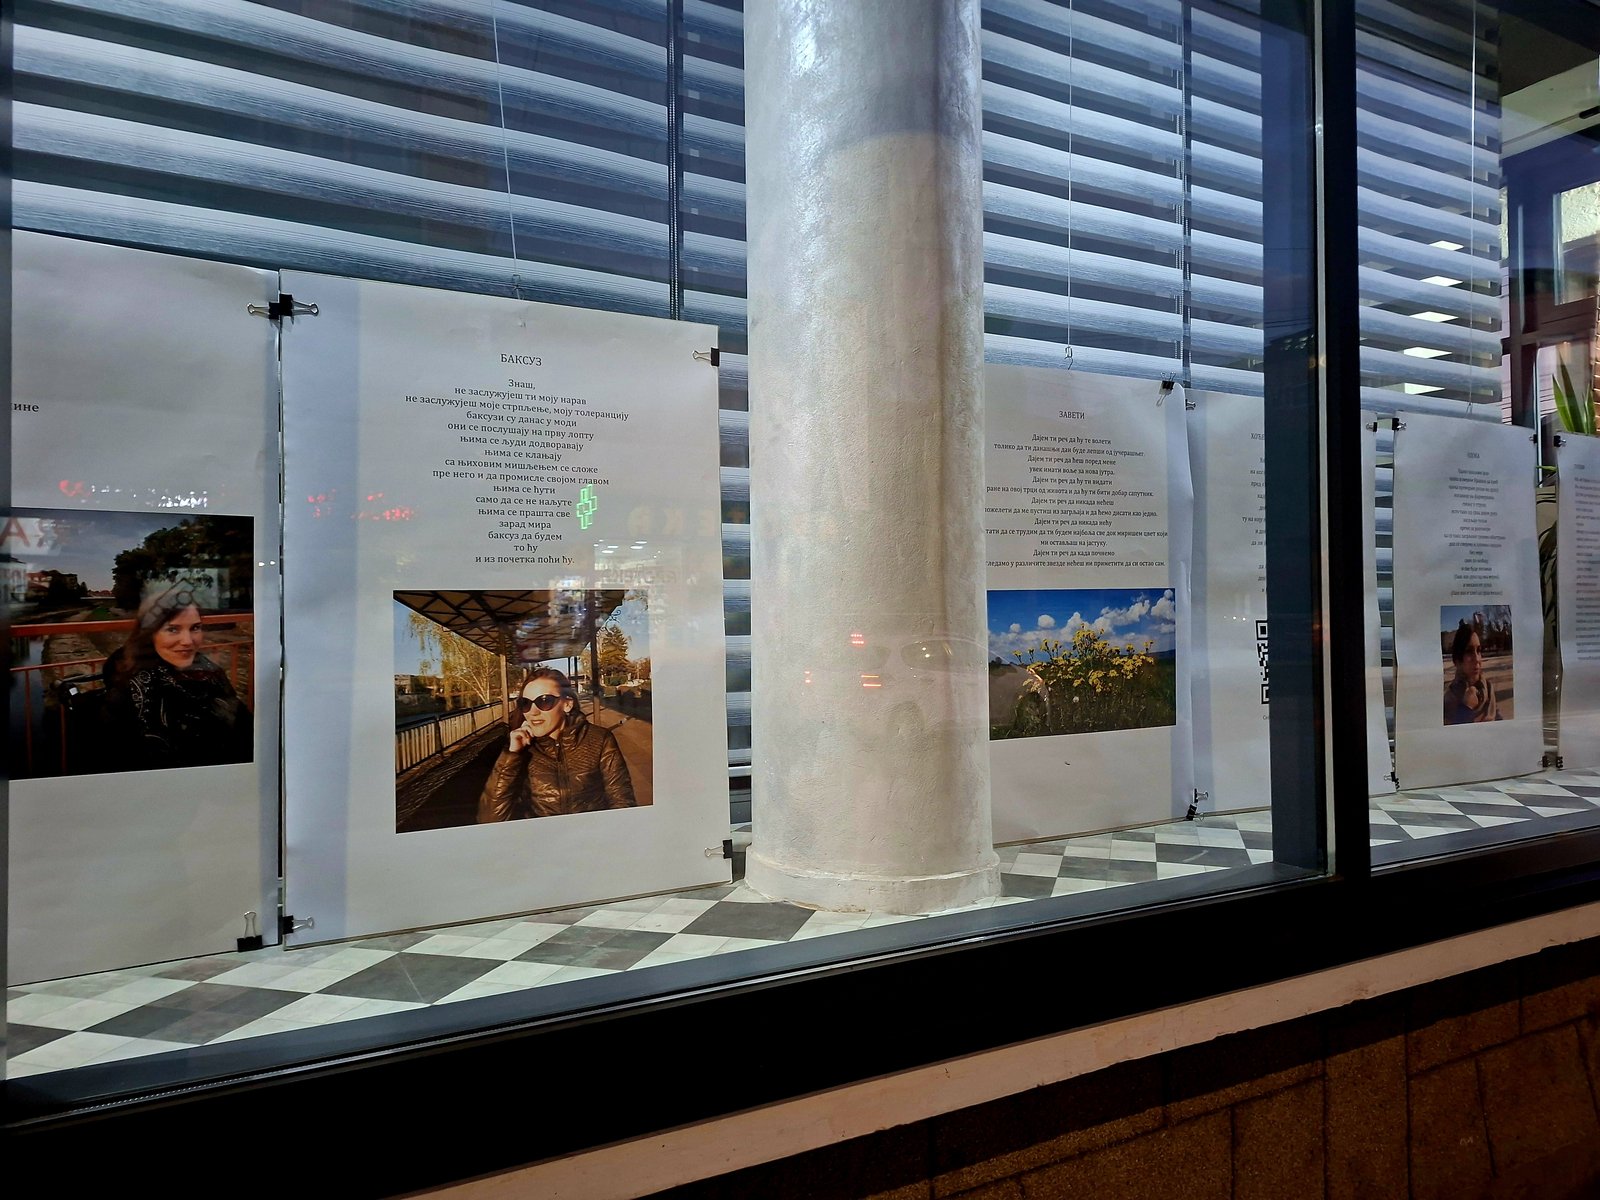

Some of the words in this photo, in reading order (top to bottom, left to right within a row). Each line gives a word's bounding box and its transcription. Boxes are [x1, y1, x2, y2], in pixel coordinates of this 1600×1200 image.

[500, 353, 542, 367] БАКСУЗ
[508, 379, 537, 391] Знаш,
[468, 389, 523, 400] заслужујеш
[538, 395, 559, 405] моју
[560, 397, 587, 406] нарав
[11, 403, 40, 412] ине
[405, 395, 418, 403] не
[419, 396, 477, 408] заслужујеш
[479, 401, 500, 411] моје
[502, 403, 552, 414] стрпљење,
[553, 407, 573, 417] моју
[574, 410, 629, 422] толеранцију
[466, 410, 504, 422] баксузи
[506, 416, 517, 424] су
[518, 416, 545, 425] данас
[546, 419, 552, 427] у
[554, 419, 577, 428] моди
[1059, 410, 1085, 420] ЗАВЕТИ
[481, 425, 530, 437] послушају
[544, 430, 566, 439] прву
[567, 432, 594, 442] лопту
[460, 436, 487, 444] њима
[501, 439, 527, 448] људи
[528, 440, 584, 452] додворавају
[484, 449, 511, 457] њима
[525, 452, 562, 462] клањају
[457, 460, 502, 468] њиховим
[504, 462, 558, 471] мишљењем
[571, 466, 598, 474] сложе
[432, 470, 451, 479] пре
[453, 471, 475, 479] него
[486, 473, 497, 481] да
[499, 474, 545, 482] промисле
[546, 475, 576, 485] својом
[493, 485, 520, 493] њима
[533, 485, 555, 496] ћути
[500, 497, 512, 505] да
[539, 499, 572, 508] наљуте
[519, 510, 554, 519] прашта
[499, 521, 526, 530] зарад
[528, 522, 551, 532] мира
[488, 530, 519, 542] баксуз
[521, 533, 532, 541] да
[534, 532, 562, 542] будем
[527, 543, 538, 554] ћу
[537, 555, 560, 564] поћи
[562, 555, 575, 566] ћу.
